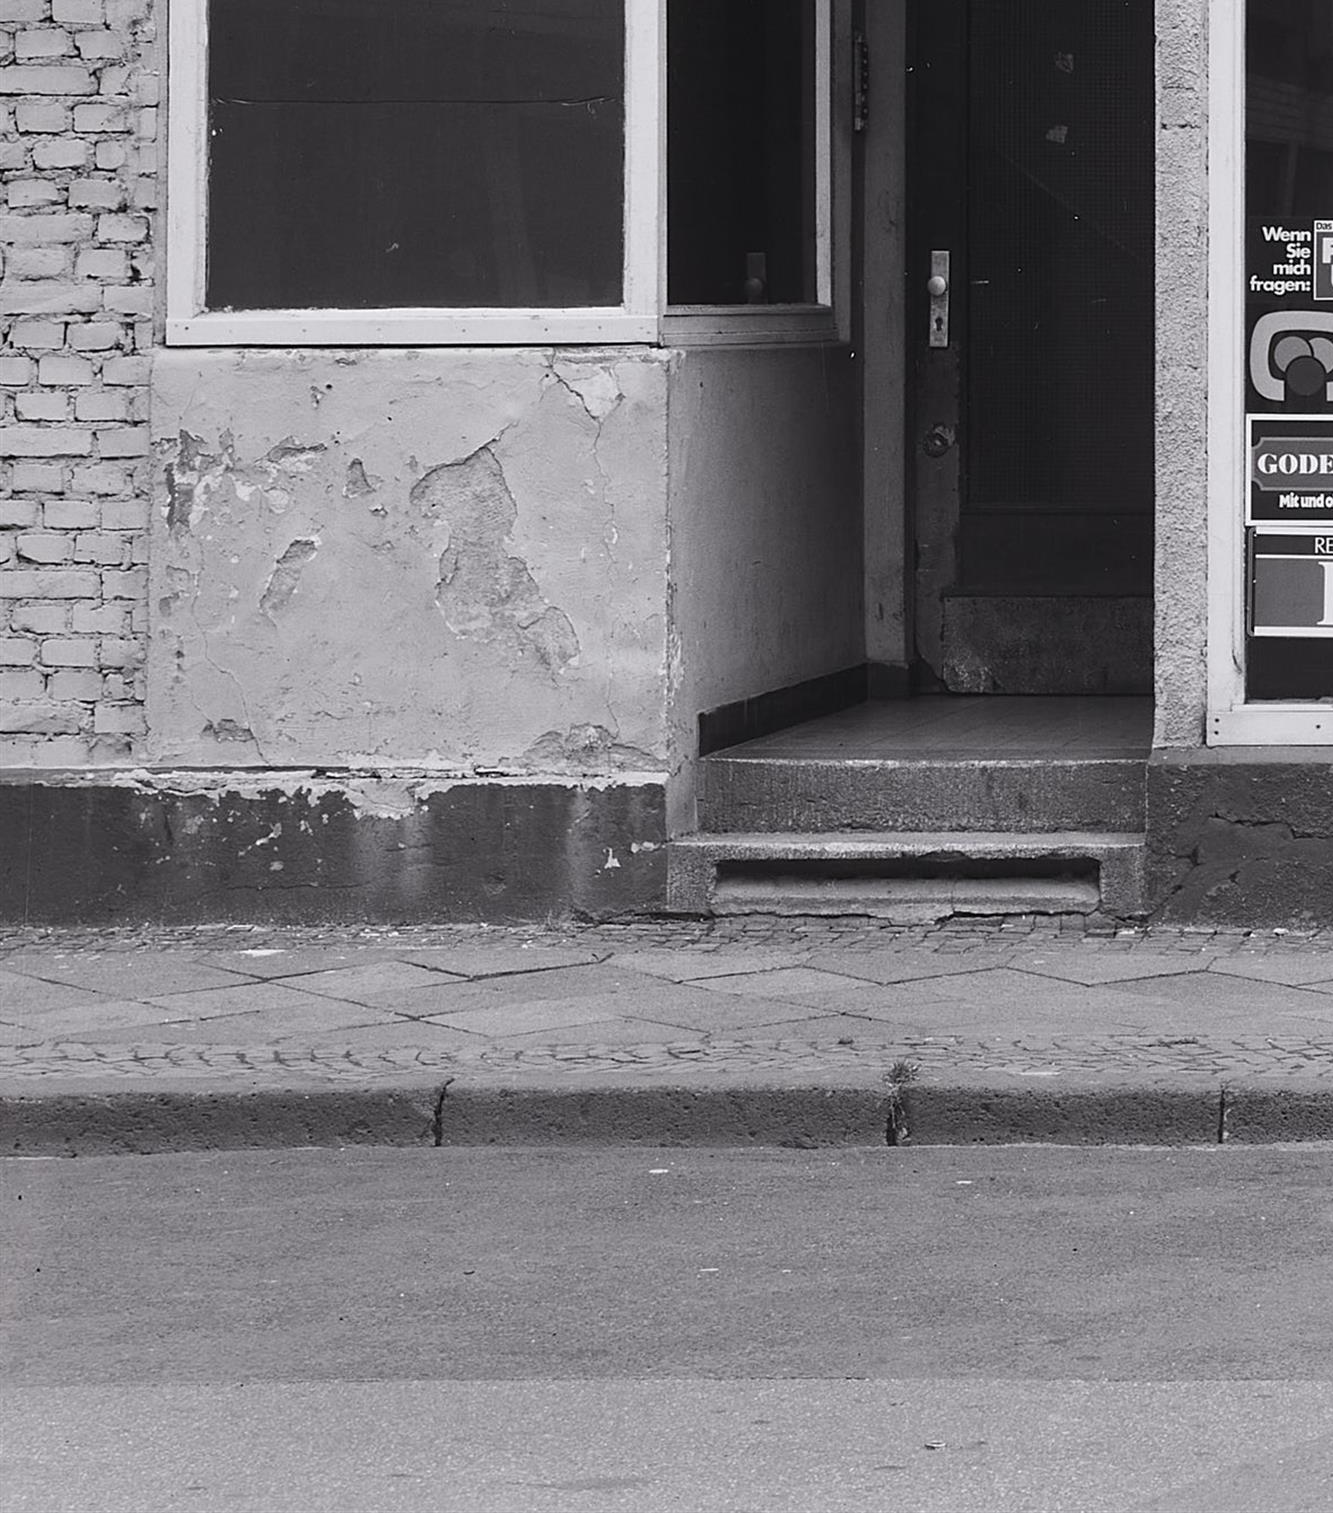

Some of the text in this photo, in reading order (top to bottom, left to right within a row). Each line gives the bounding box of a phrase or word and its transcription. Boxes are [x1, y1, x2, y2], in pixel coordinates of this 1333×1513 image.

[1262, 226, 1311, 241] Wenn
[1315, 222, 1332, 231] Das
[1286, 242, 1311, 259] Sie
[1273, 259, 1311, 276] mich
[1250, 276, 1311, 294] fragen:
[1279, 492, 1300, 509] Mit
[1301, 492, 1324, 509] und
